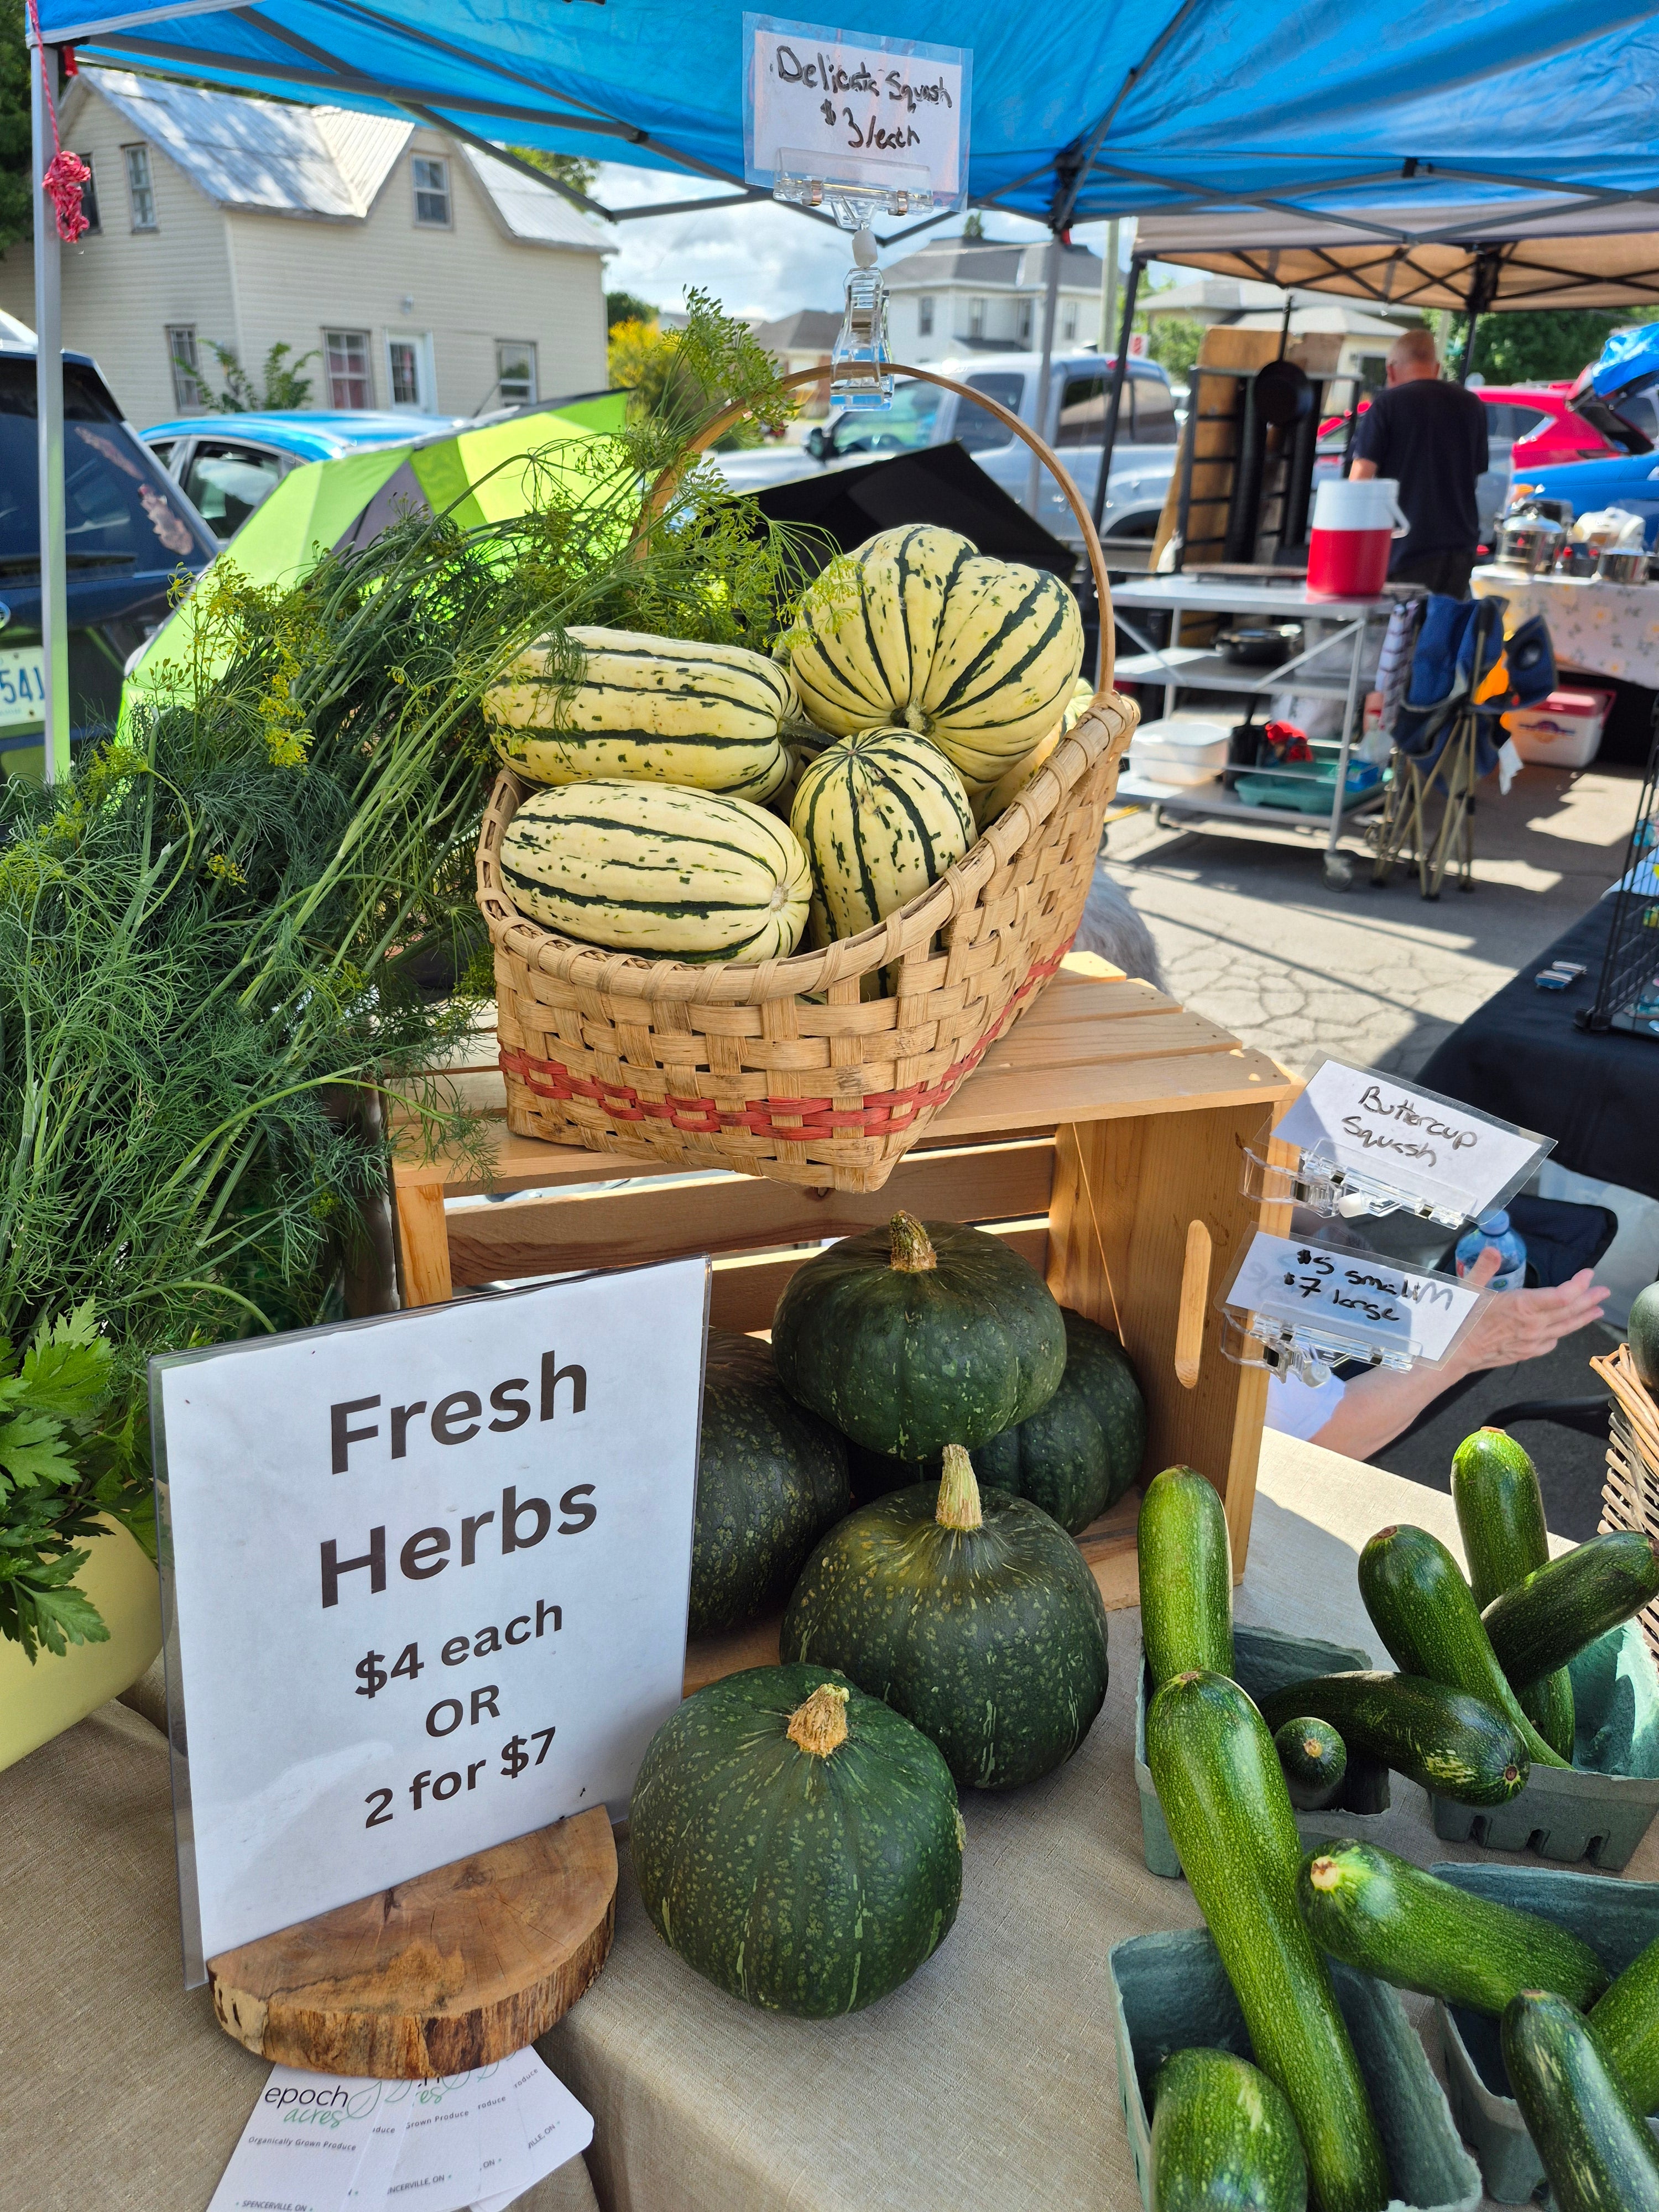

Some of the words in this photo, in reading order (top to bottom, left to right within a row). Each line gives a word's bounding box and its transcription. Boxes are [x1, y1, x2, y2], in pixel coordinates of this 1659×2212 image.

[885, 70, 953, 113] Squash
[1358, 1086, 1478, 1150] Buttercup
[1342, 1116, 1437, 1167] Squash
[331, 1350, 587, 1475] Fresh
[321, 1484, 597, 1608] Herbs
[355, 1642, 425, 1699] $4
[441, 1599, 562, 1666] each
[426, 1684, 500, 1738] OR
[364, 1788, 393, 1829] 2
[409, 1759, 487, 1811] for
[500, 1726, 556, 1779] $7
[514, 2069, 538, 2088] roduce
[264, 2085, 348, 2109] epoch
[478, 2096, 506, 2109] roduce
[284, 2107, 343, 2128] acres
[435, 2110, 469, 2122] Produce
[544, 2124, 555, 2135] ON
[249, 2136, 293, 2146] Organically
[295, 2138, 320, 2147] Grown
[324, 2141, 356, 2152] Produce
[483, 2159, 495, 2168] ON
[433, 2174, 445, 2183] ON
